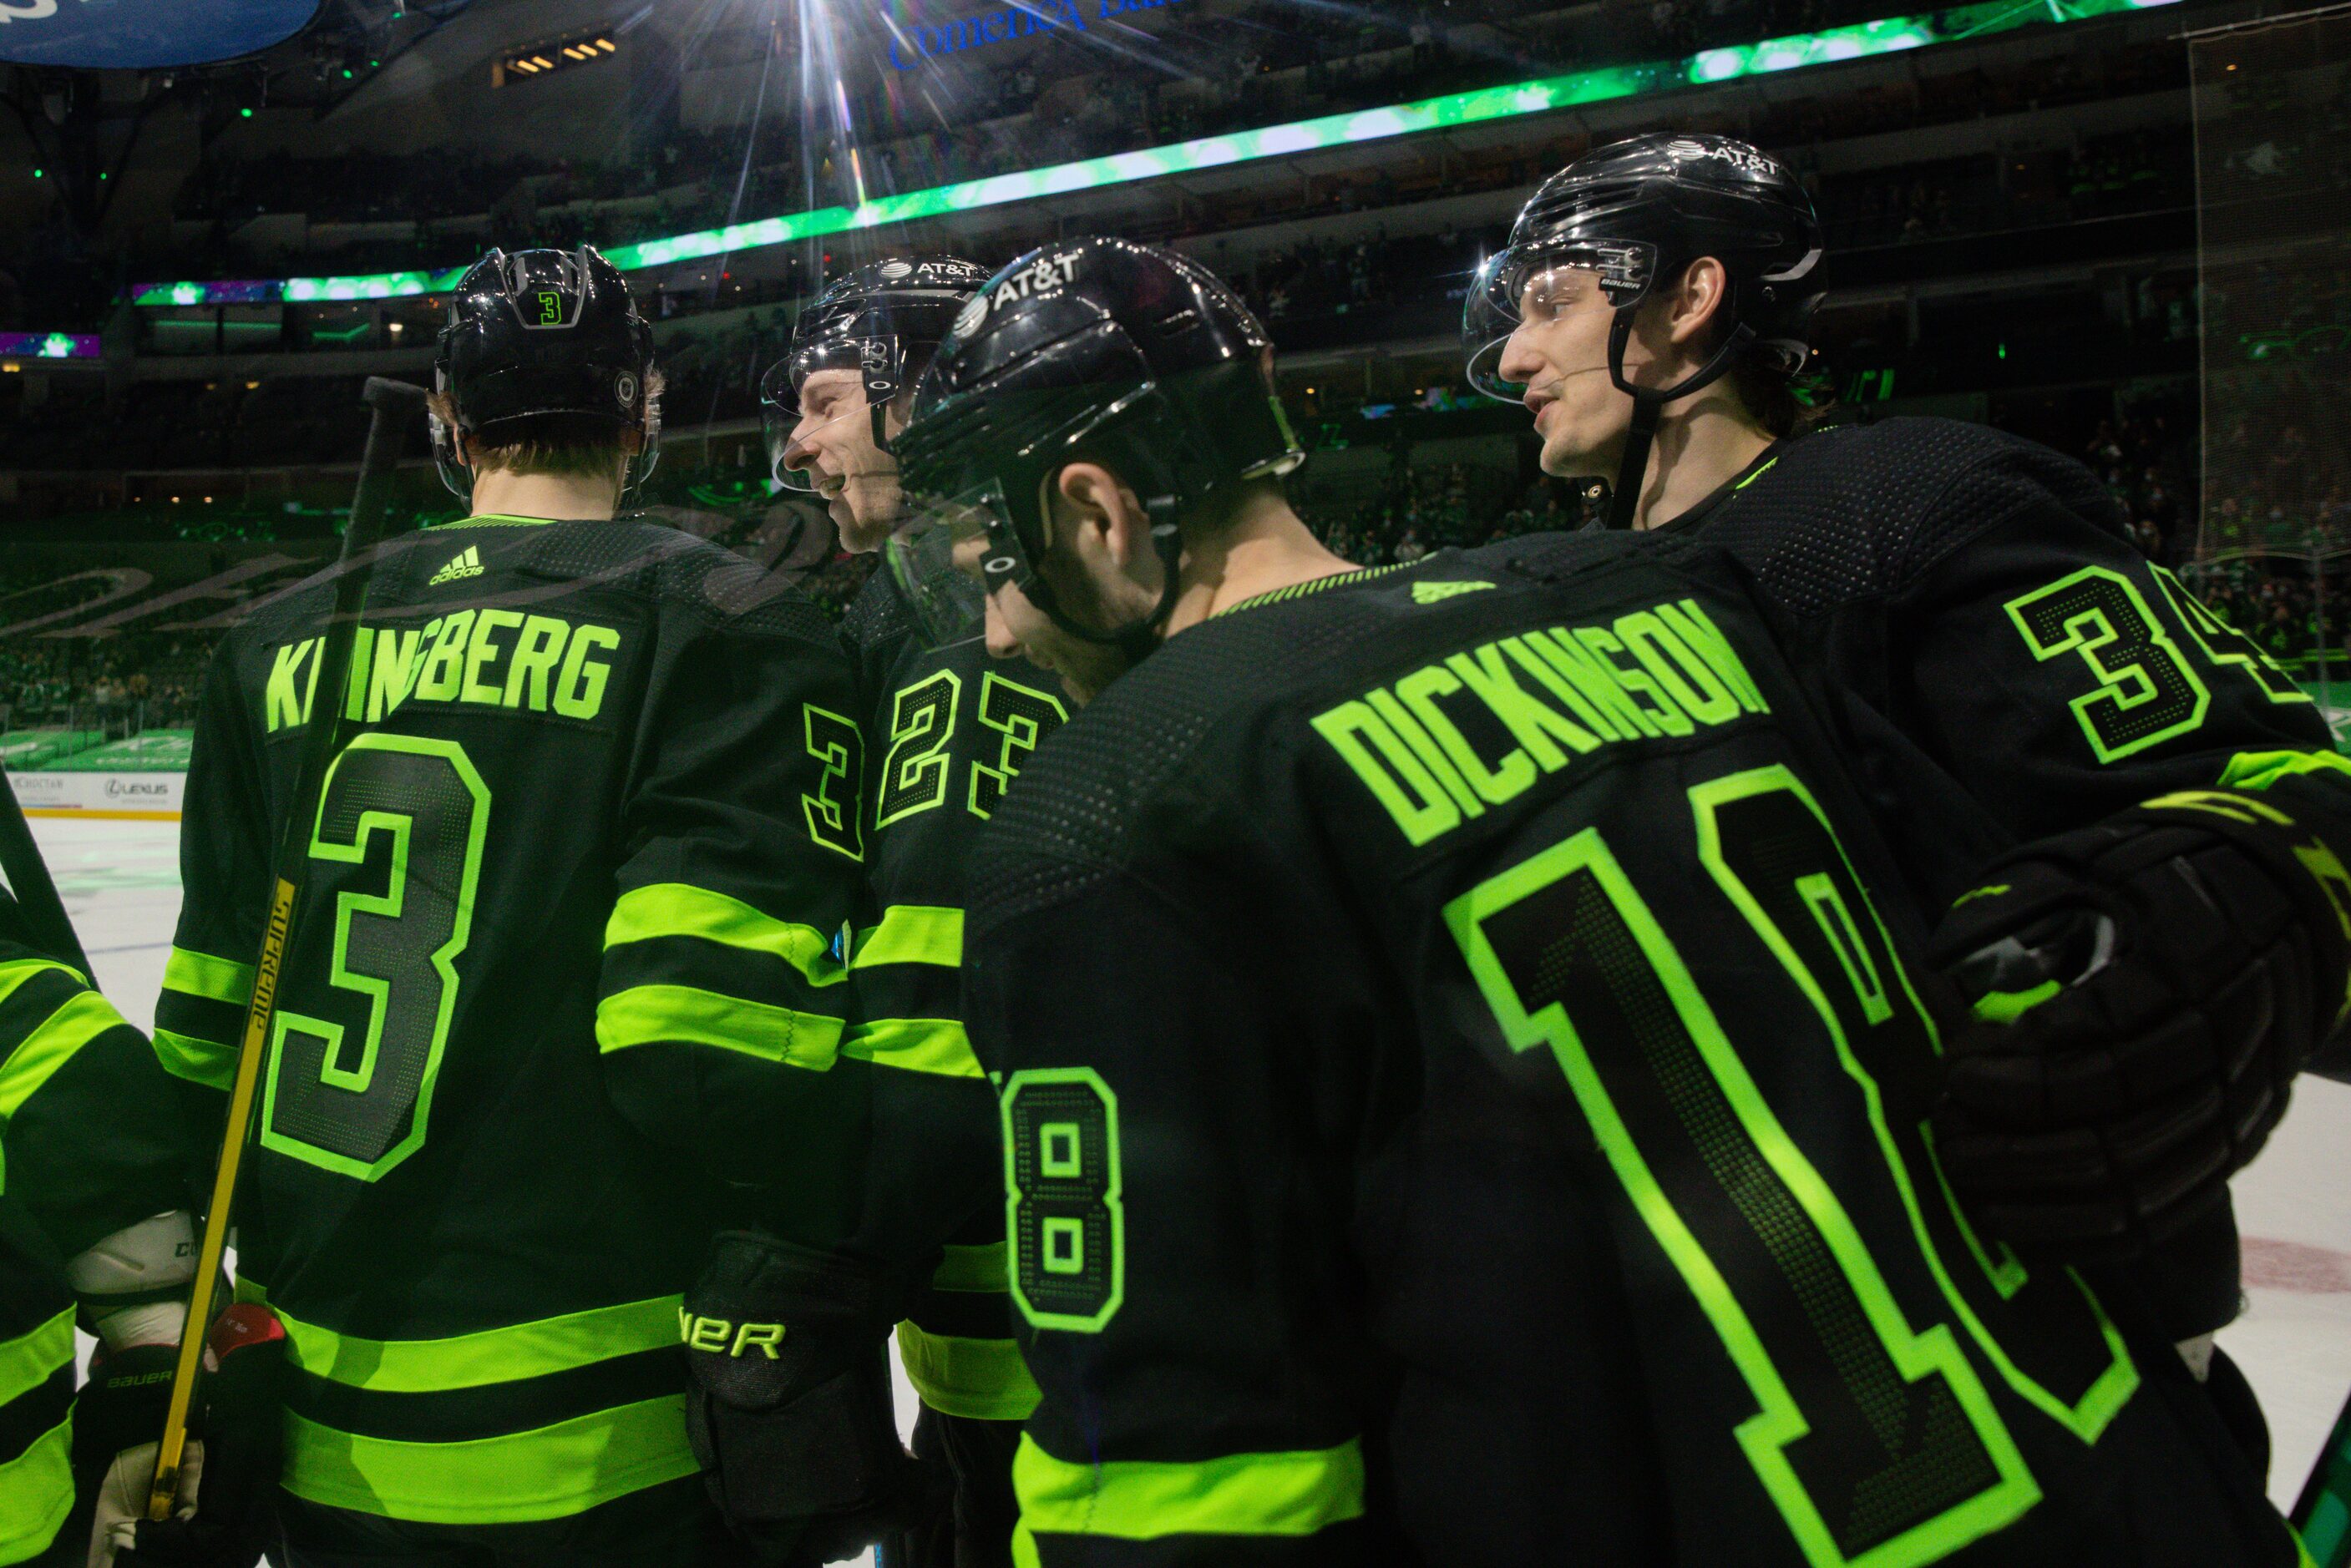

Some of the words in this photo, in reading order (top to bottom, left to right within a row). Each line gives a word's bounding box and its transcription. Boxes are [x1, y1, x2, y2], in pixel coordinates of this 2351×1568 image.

[1712, 146, 1779, 175] AT&T
[538, 291, 562, 326] 3
[917, 262, 974, 277] AT&T
[993, 253, 1080, 311] AT&T
[428, 565, 485, 586] adidas
[2002, 559, 2315, 765] 34
[874, 668, 1071, 826] 23
[1309, 598, 1773, 848] DICKINSON
[123, 784, 169, 796] LEXUS
[800, 701, 866, 863] 3
[260, 732, 492, 1183] 3
[1441, 763, 2142, 1568] 18
